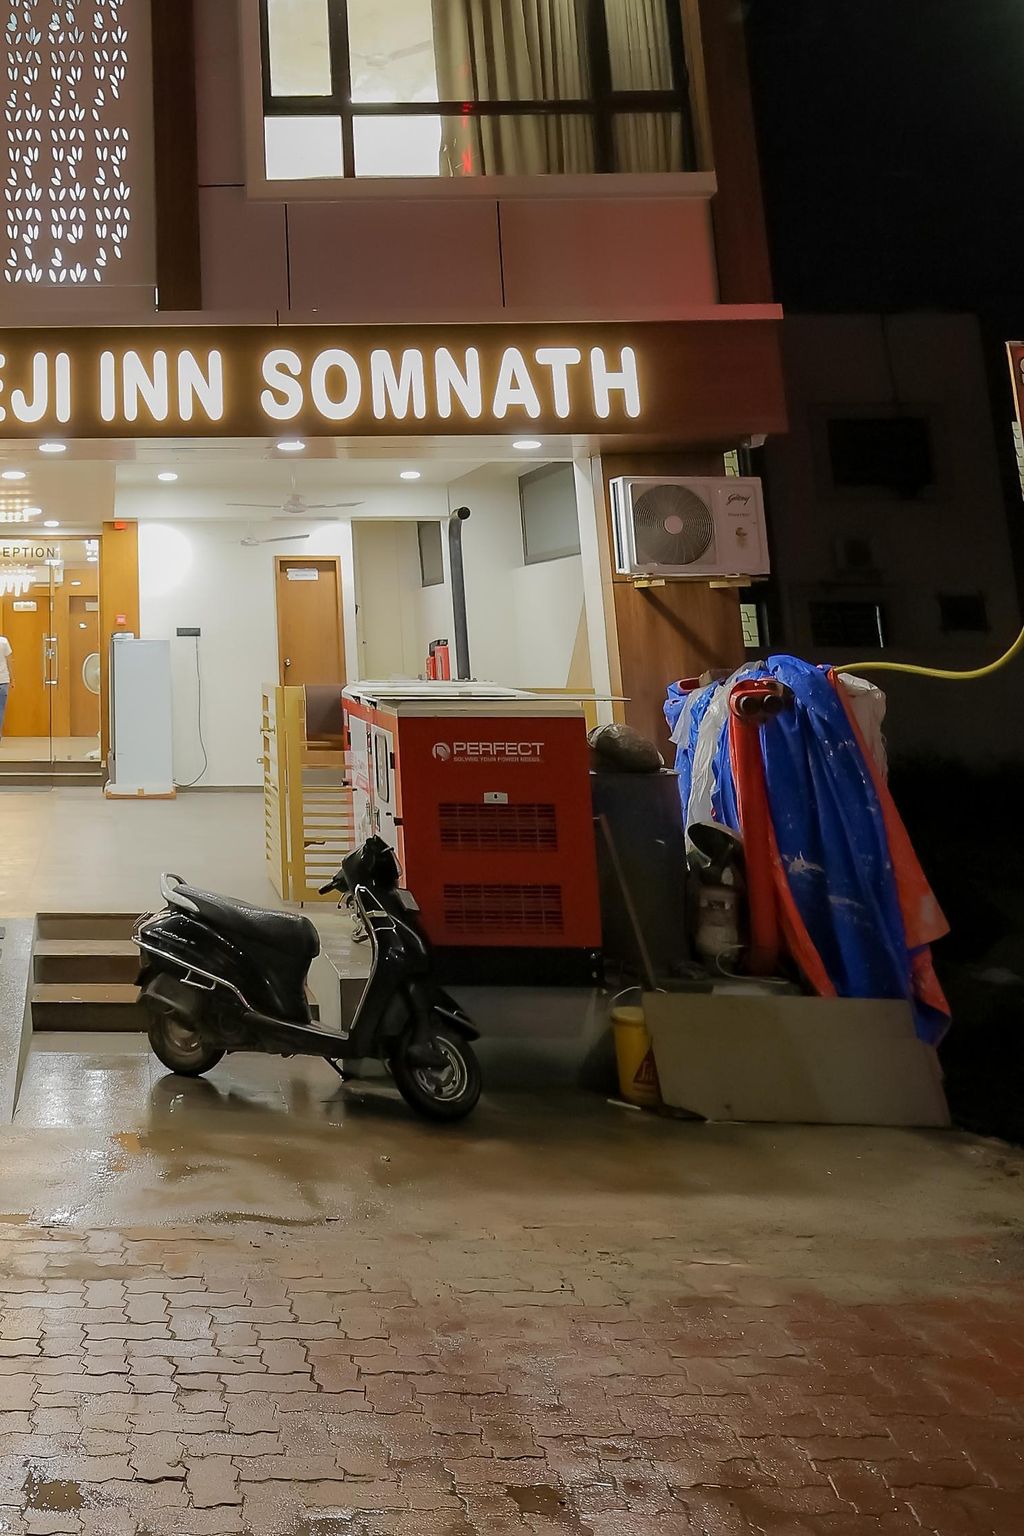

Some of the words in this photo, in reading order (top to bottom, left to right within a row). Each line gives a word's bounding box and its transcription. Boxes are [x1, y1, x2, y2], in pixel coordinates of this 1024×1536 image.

[100, 350, 224, 422] INN
[260, 346, 642, 420] SOMNATH
[453, 742, 545, 756] PERFECT
